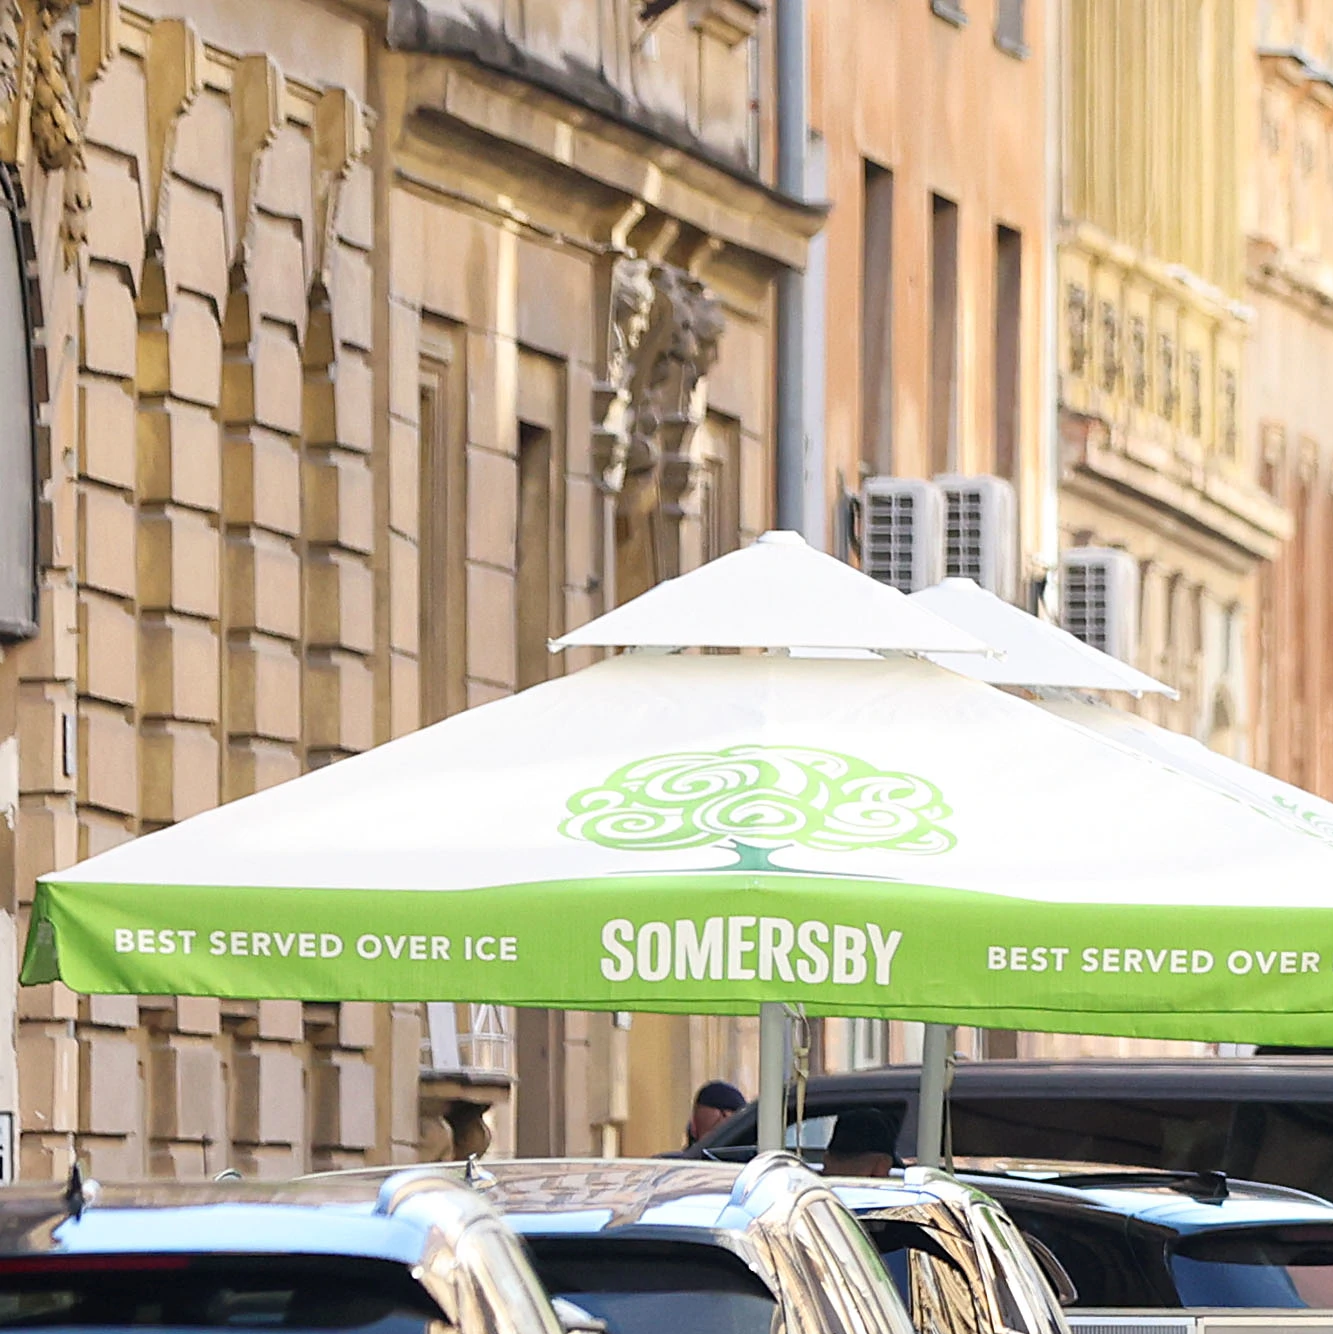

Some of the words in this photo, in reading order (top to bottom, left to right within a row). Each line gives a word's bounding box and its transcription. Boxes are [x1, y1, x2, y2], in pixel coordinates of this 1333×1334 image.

[114, 929, 197, 954] BEST
[209, 931, 343, 958] SERVED
[356, 934, 450, 960] OVER
[464, 937, 518, 961] ICE
[600, 916, 902, 985] SOMERSBY
[987, 946, 1069, 972] BEST
[1081, 947, 1214, 974] SERVED
[1227, 950, 1320, 975] OVER
